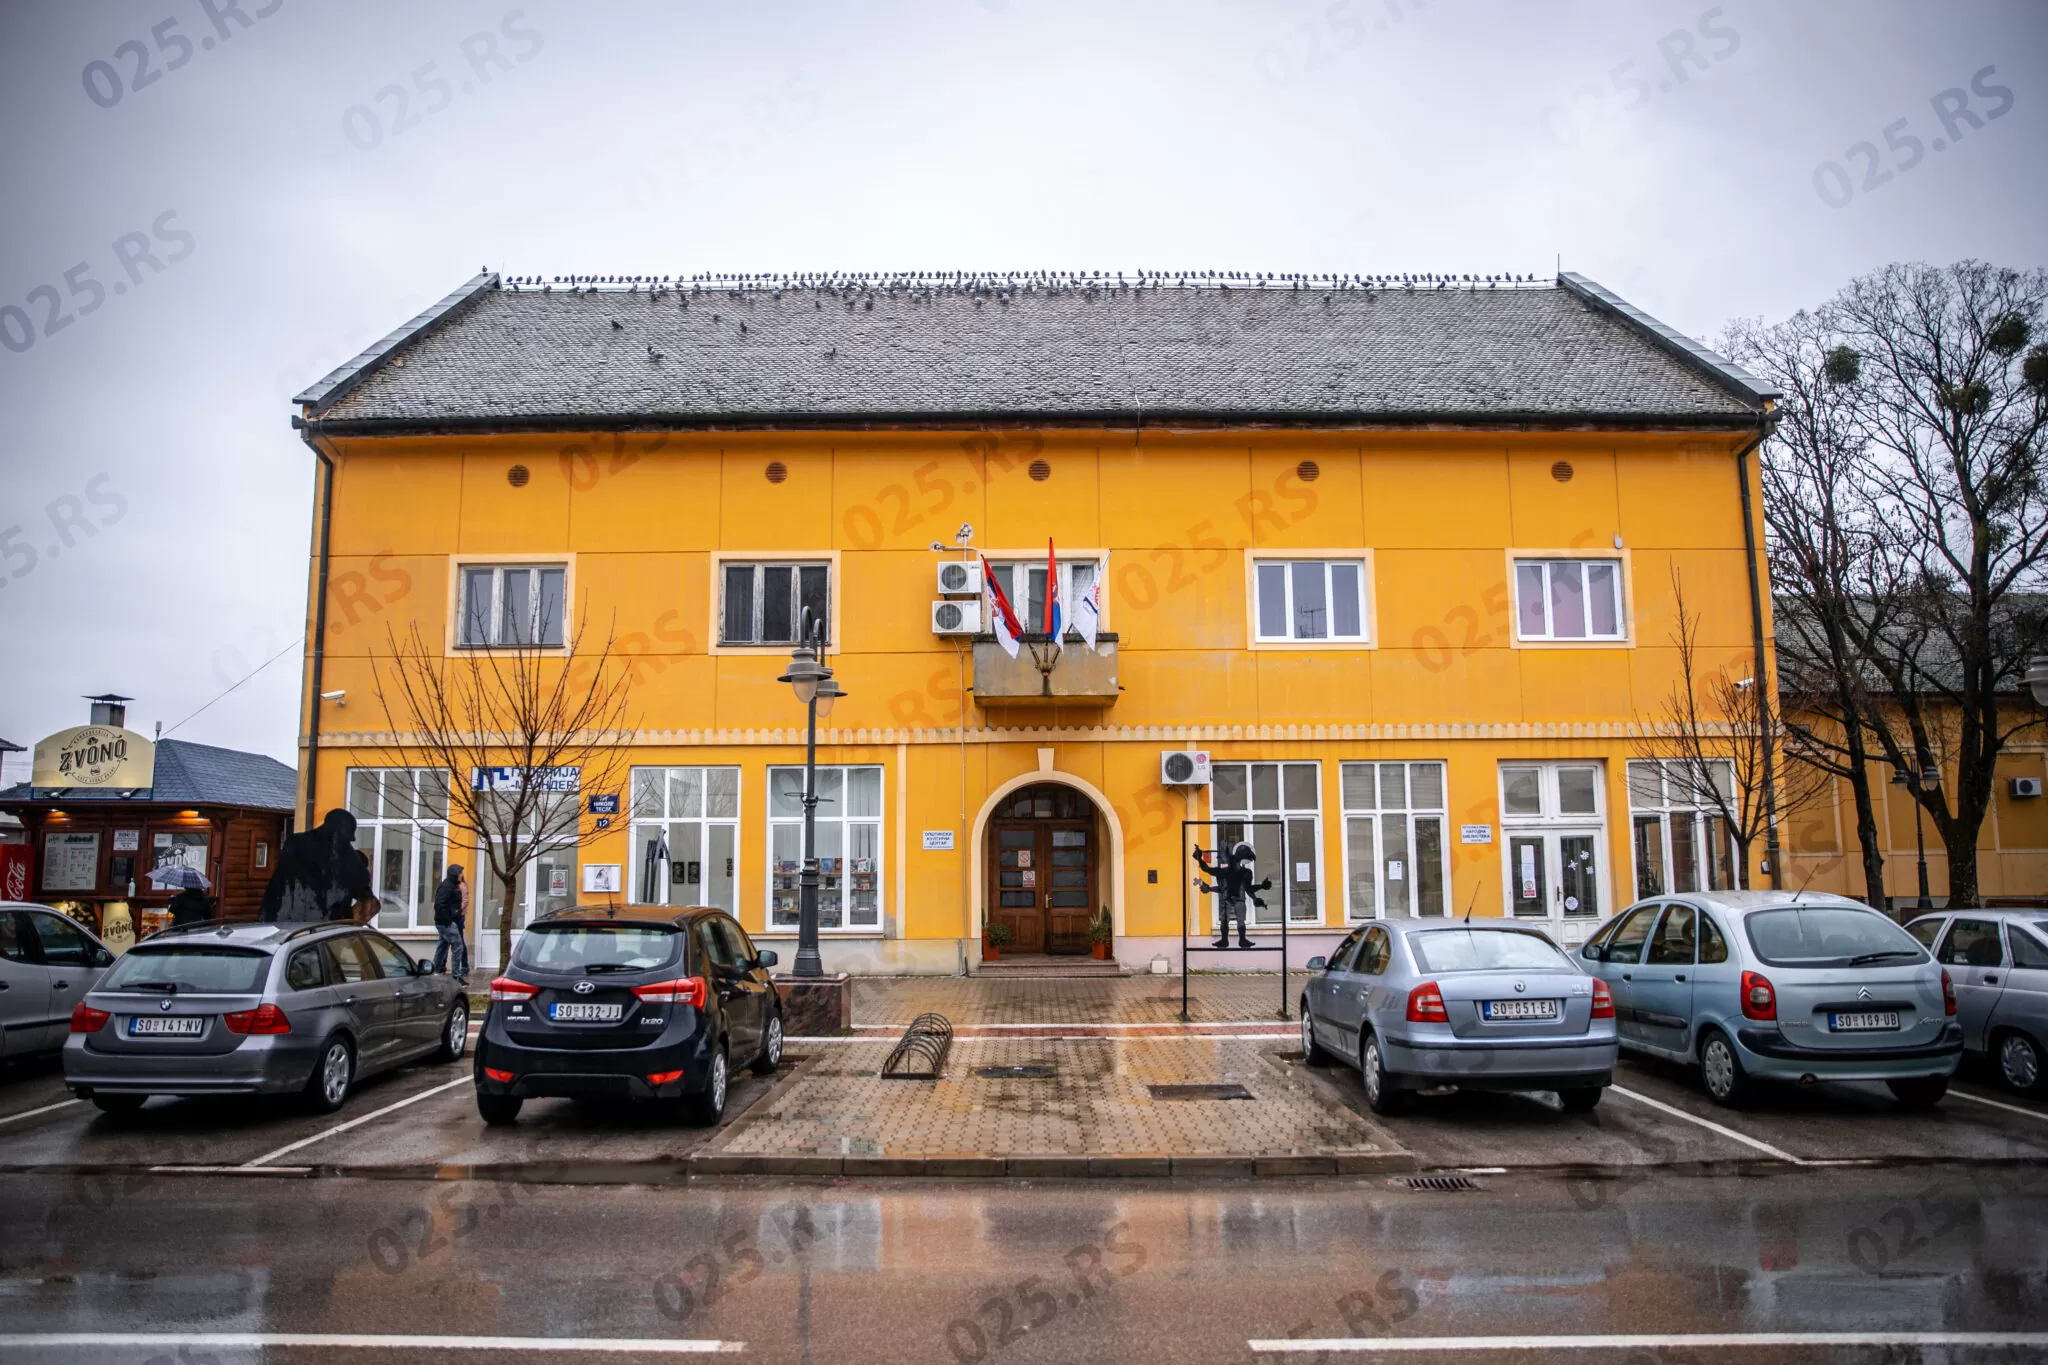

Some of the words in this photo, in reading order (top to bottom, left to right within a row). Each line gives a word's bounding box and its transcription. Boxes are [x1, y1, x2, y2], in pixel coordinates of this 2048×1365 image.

[599, 819, 608, 827] 12
[7, 857, 26, 901] Cola
[557, 1005, 572, 1017] SO
[1493, 1003, 1507, 1014] SO
[138, 1019, 152, 1031] SO
[1838, 1015, 1851, 1027] SO
